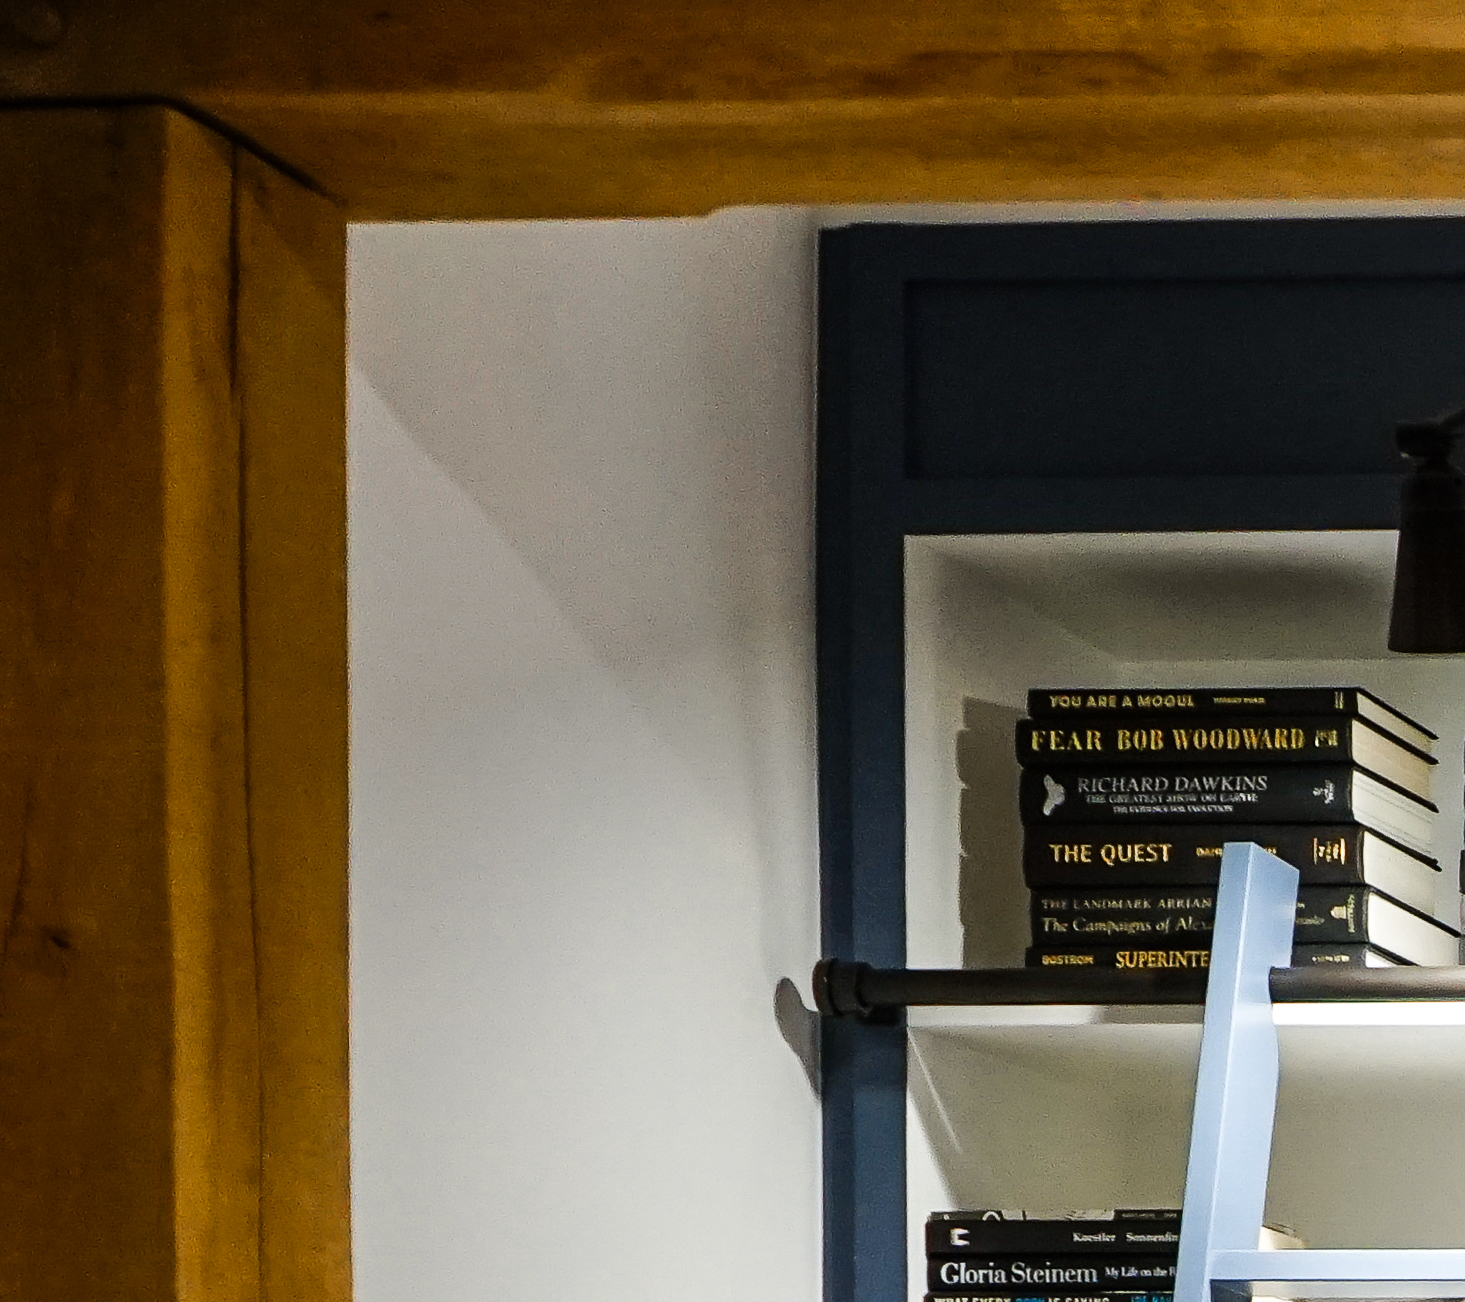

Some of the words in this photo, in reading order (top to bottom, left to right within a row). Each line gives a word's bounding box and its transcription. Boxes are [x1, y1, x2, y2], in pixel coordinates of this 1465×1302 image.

[1031, 730, 1102, 750] FEAR
[1117, 730, 1163, 750] BOB
[1172, 729, 1305, 750] WOODWARD
[1078, 777, 1170, 792] RICHARD
[1175, 776, 1268, 791] DAWKINS
[1050, 844, 1092, 862] THE
[1100, 844, 1172, 864] QUEST
[941, 1262, 1006, 1284] Gloria
[1011, 1262, 1098, 1282] Steinem
